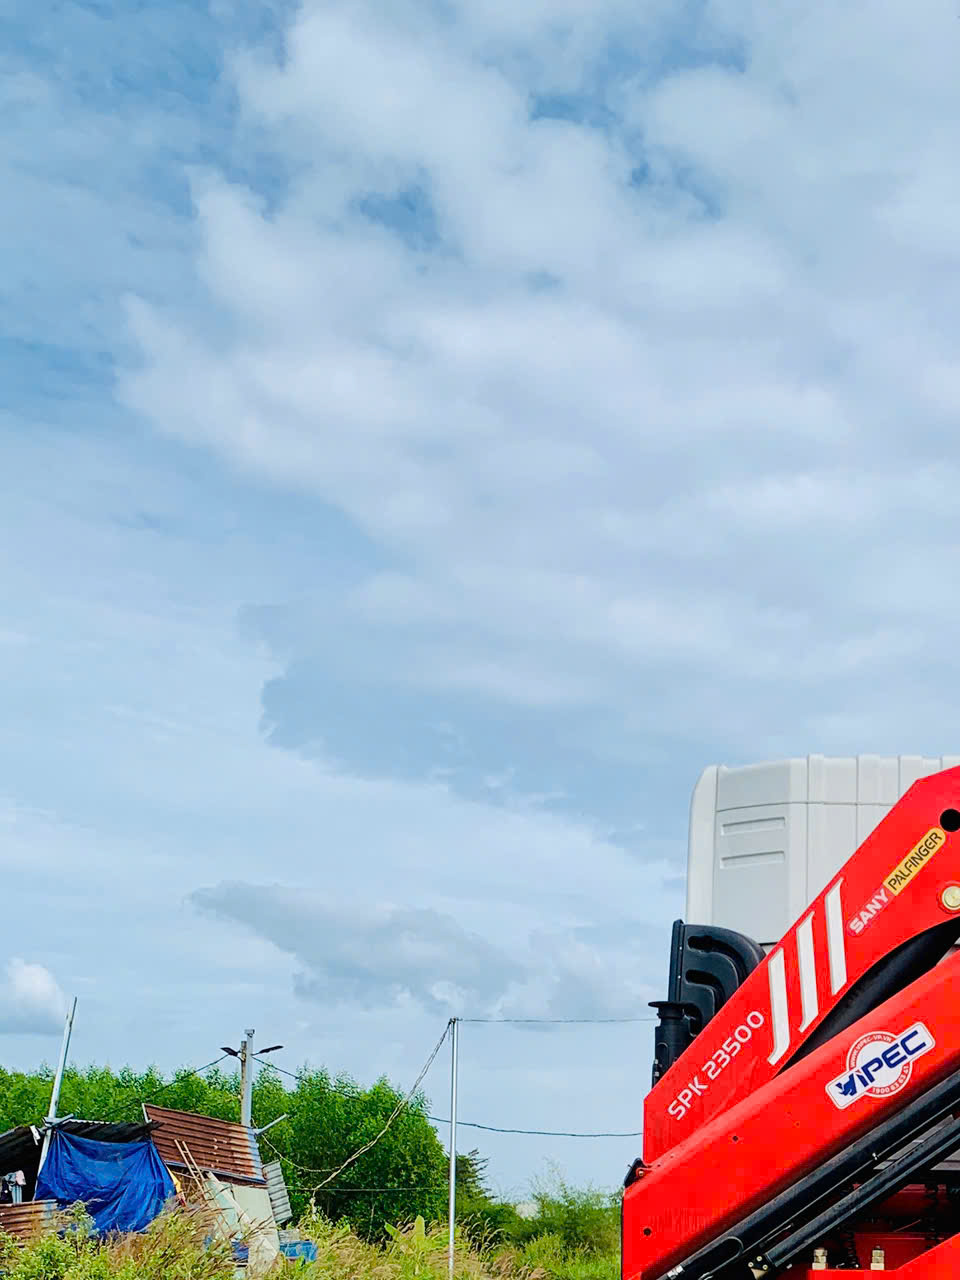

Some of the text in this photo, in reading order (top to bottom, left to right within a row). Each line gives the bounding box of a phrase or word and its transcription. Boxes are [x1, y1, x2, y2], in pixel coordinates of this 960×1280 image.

[849, 832, 942, 934] SANY PALFINGER
[667, 1010, 765, 1121] SPK 23500
[872, 1086, 890, 1095] 1900
